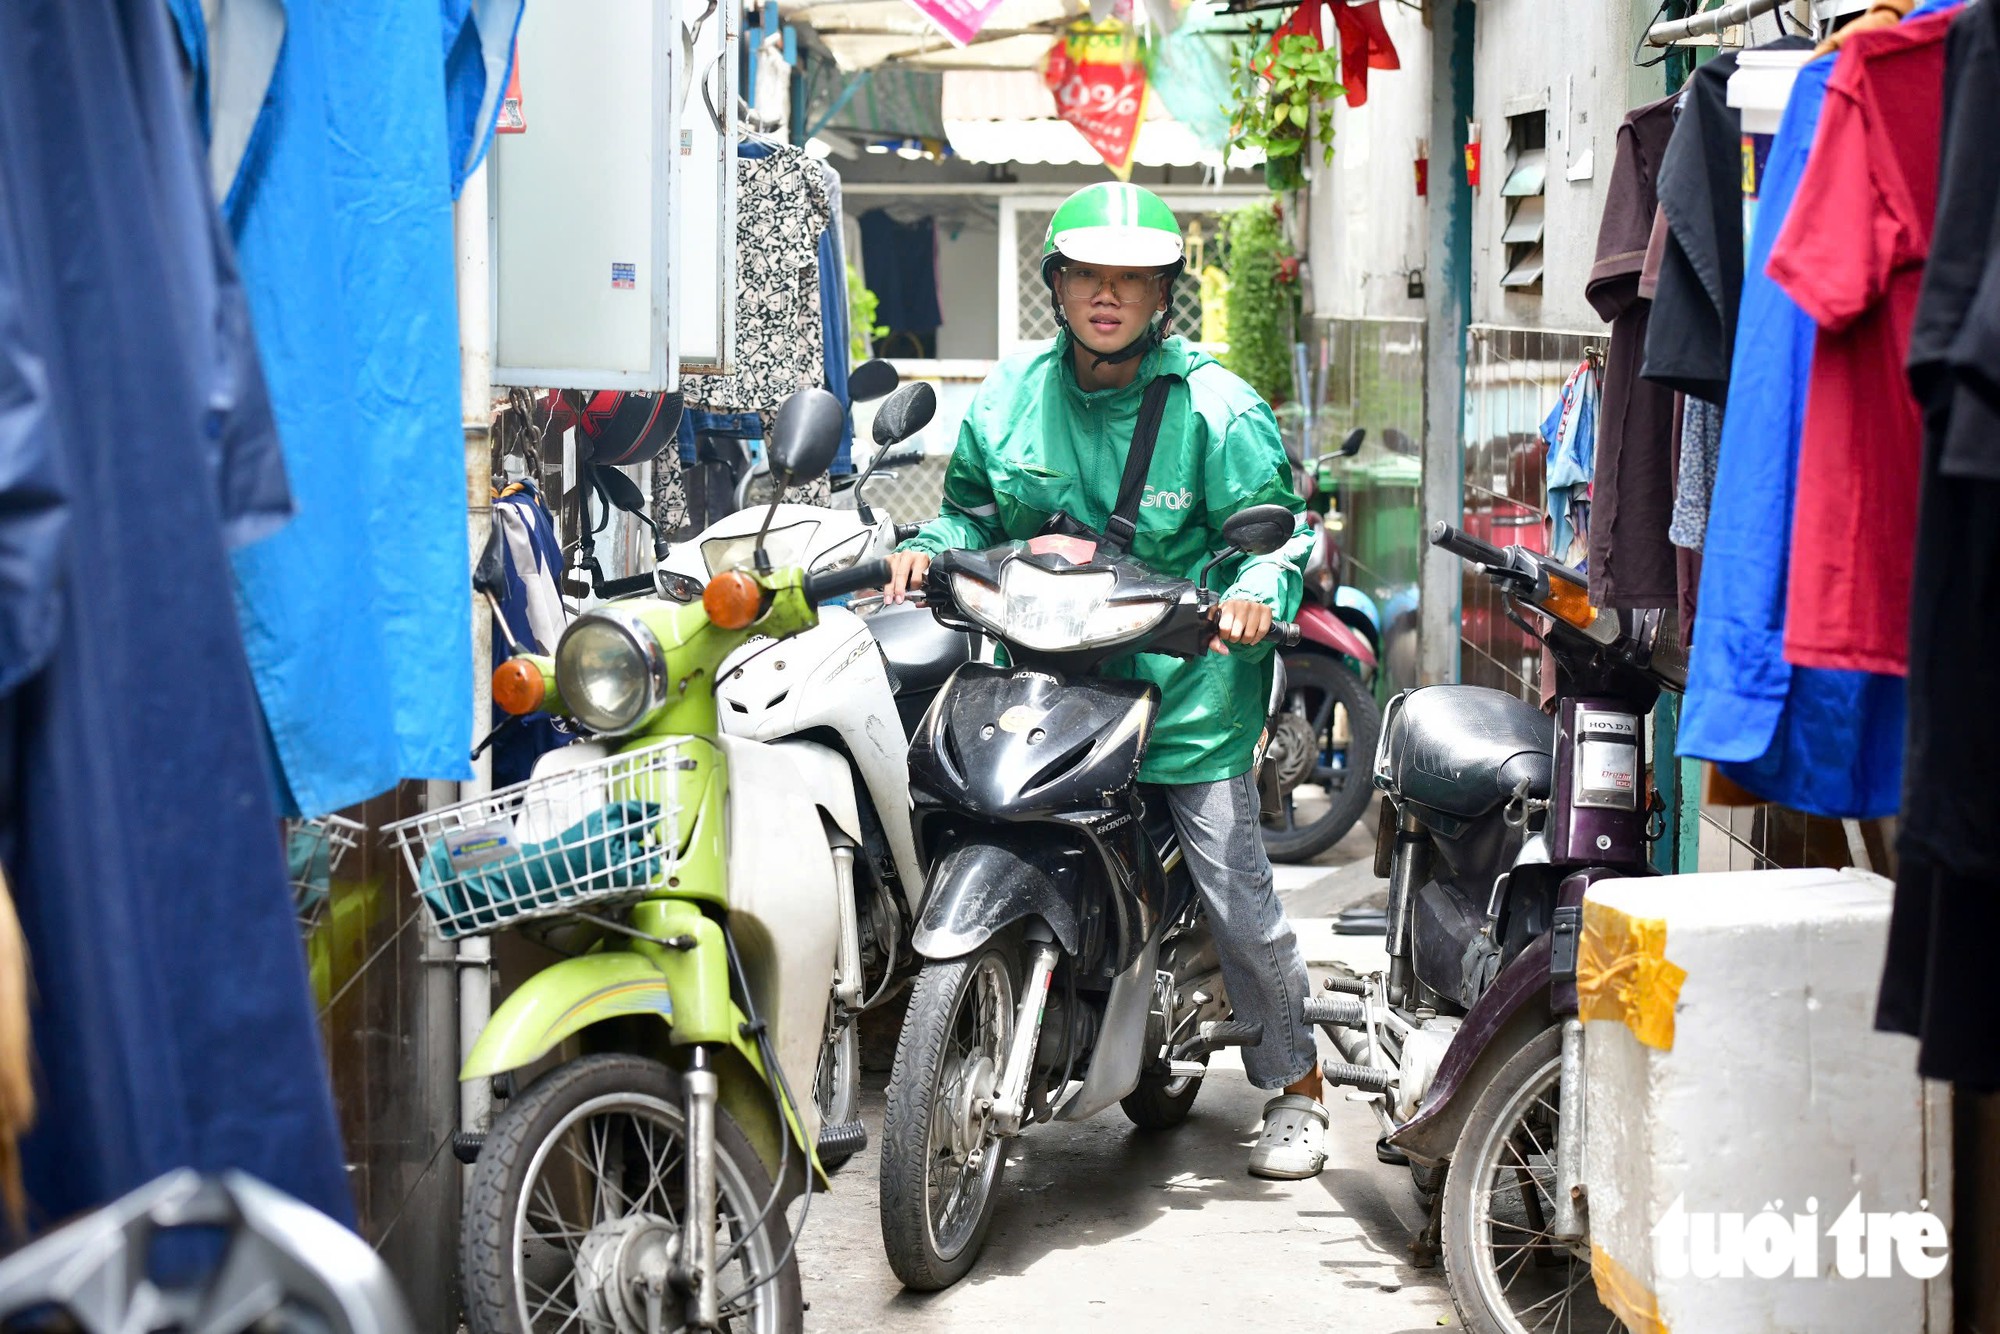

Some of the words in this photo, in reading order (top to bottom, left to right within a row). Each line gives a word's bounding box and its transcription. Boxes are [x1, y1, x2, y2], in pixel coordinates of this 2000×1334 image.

[1140, 485, 1193, 510] Grab
[1012, 671, 1059, 686] HONDA
[1589, 722, 1632, 731] HONDA
[1097, 814, 1132, 834] HONDA
